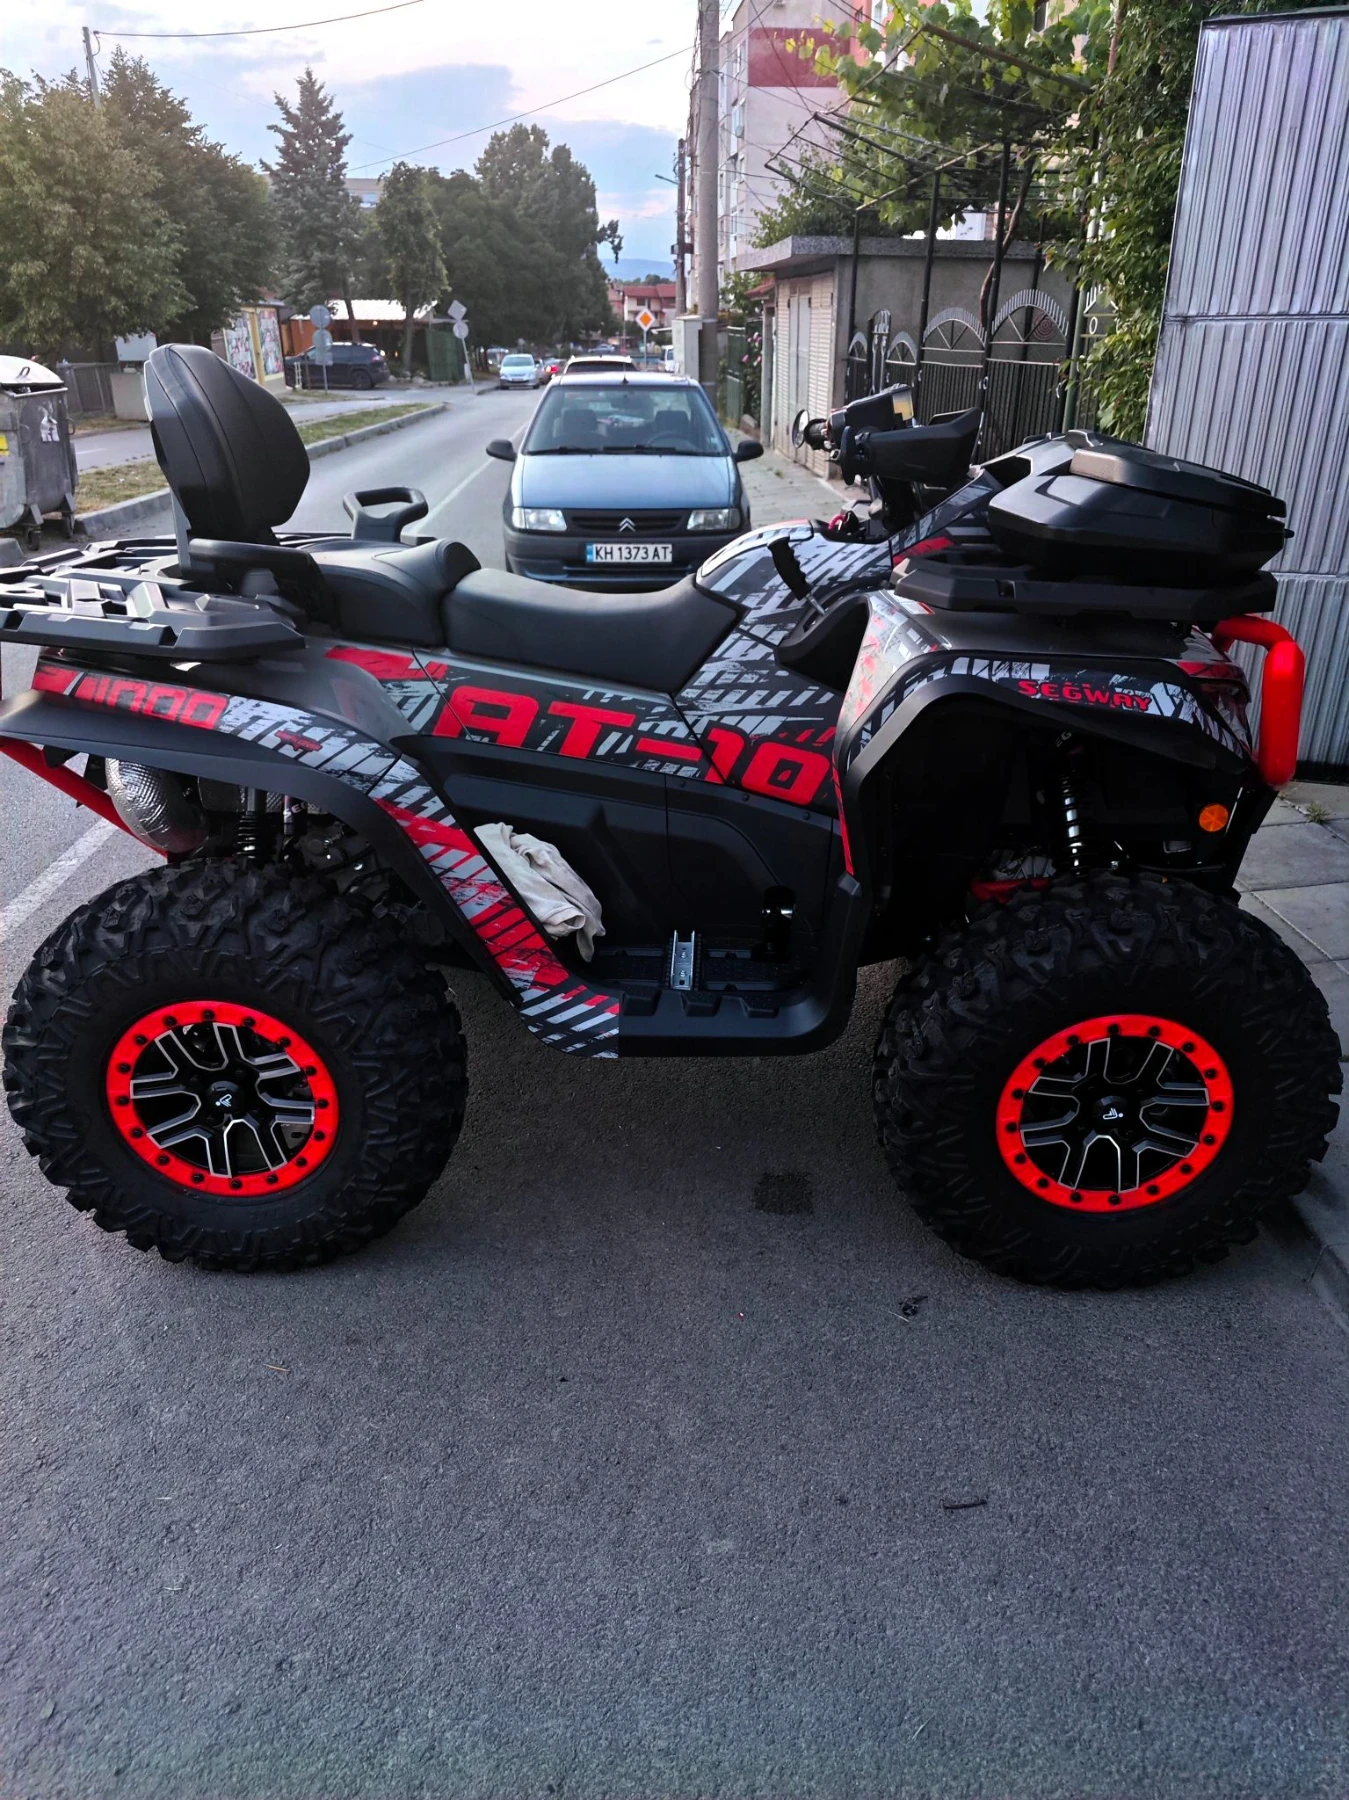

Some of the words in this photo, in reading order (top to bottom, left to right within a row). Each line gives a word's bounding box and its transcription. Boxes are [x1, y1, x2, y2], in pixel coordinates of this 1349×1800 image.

[595, 546, 613, 560] KH
[618, 546, 649, 560] 1373
[653, 546, 669, 560] AT
[1018, 680, 1152, 712] SEGWAY
